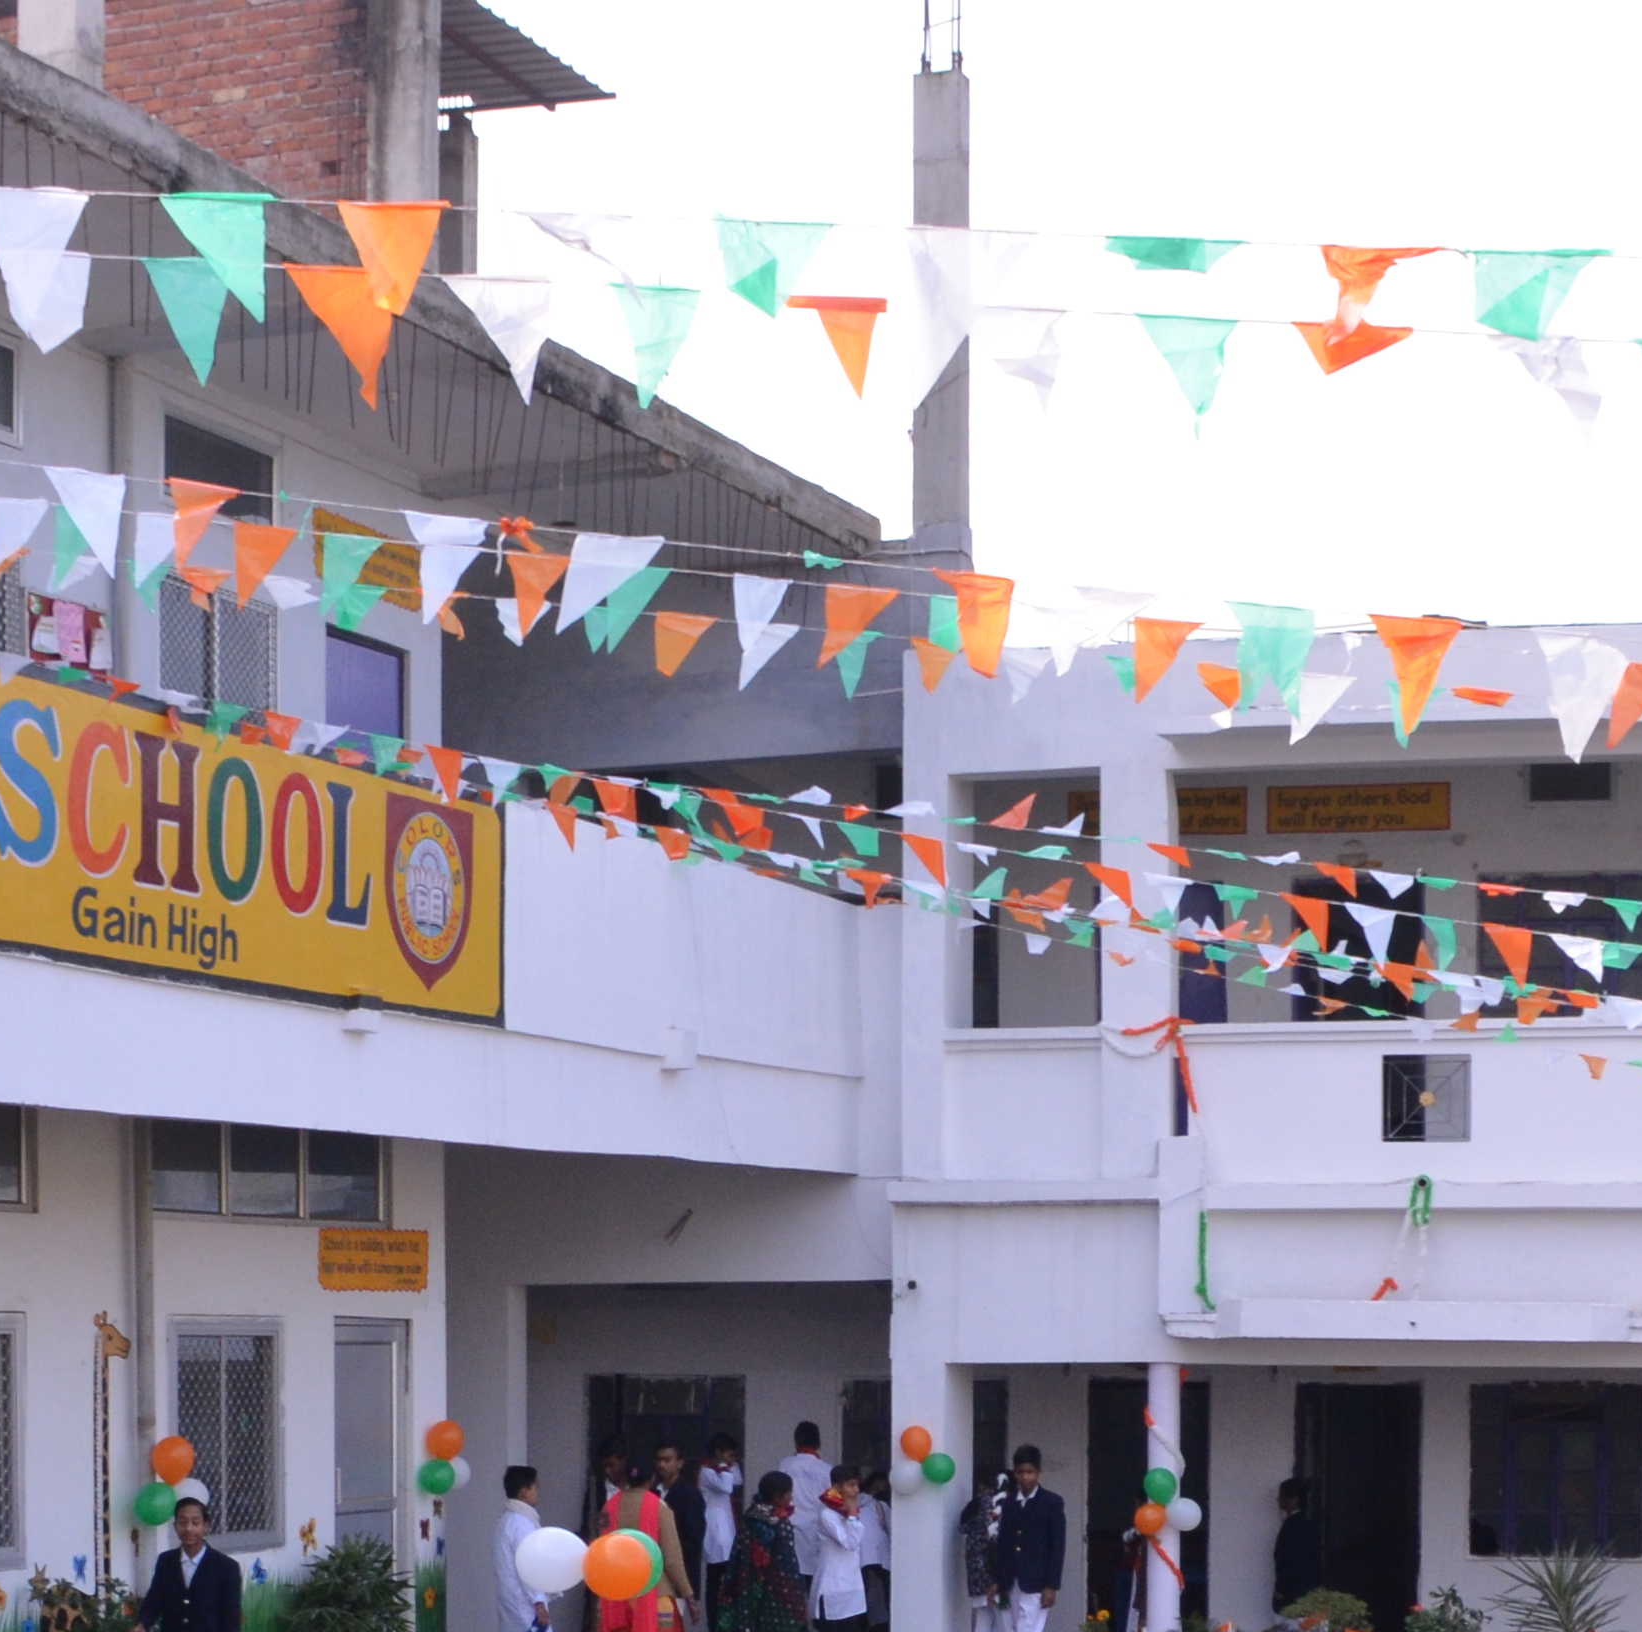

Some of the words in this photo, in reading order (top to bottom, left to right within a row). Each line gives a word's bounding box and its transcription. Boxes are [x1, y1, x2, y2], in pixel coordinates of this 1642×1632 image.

[1397, 788, 1431, 805] God
[1278, 812, 1306, 828] will
[1312, 812, 1368, 829] forgive
[72, 886, 157, 950] Gain
[165, 900, 239, 970] High
